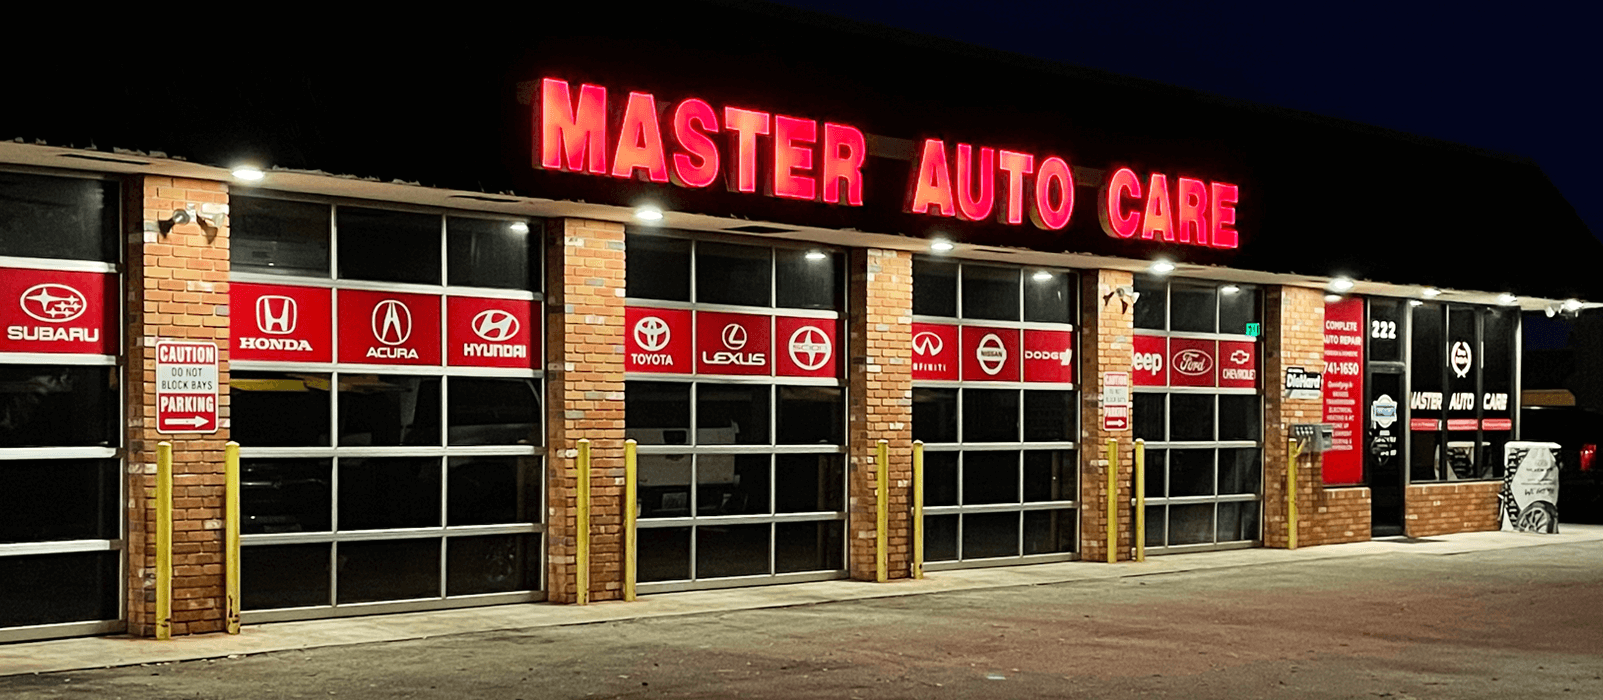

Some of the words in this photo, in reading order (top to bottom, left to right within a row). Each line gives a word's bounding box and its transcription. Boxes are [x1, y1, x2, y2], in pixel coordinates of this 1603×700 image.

[539, 77, 866, 206] MASTER
[912, 138, 1075, 230] AUTO
[1107, 167, 1240, 249] CARE
[7, 325, 99, 342] SUBARU
[1325, 320, 1358, 332] COMPLETE
[1371, 320, 1397, 339] 222
[239, 337, 313, 351] HONDA
[1340, 335, 1362, 346] REPAIR
[159, 346, 214, 363] CAUTION
[366, 347, 419, 359] ACURA
[463, 343, 527, 358] HYUNDAI
[981, 350, 1003, 358] NISSAN
[631, 353, 673, 366] TOYOTA
[702, 351, 766, 366] LEXUS
[1132, 352, 1163, 376] eep
[1179, 352, 1206, 372] Ford
[171, 367, 183, 376] DO
[185, 367, 203, 377] NOT
[912, 362, 947, 372] NFINITI
[1323, 362, 1359, 375] 741-1650
[161, 380, 188, 390] BLOCK
[191, 381, 213, 390] BAYS
[1286, 373, 1321, 389] DieHard
[160, 396, 214, 413] PARKING
[1448, 392, 1475, 411] AUTO
[1483, 392, 1508, 411] CARE
